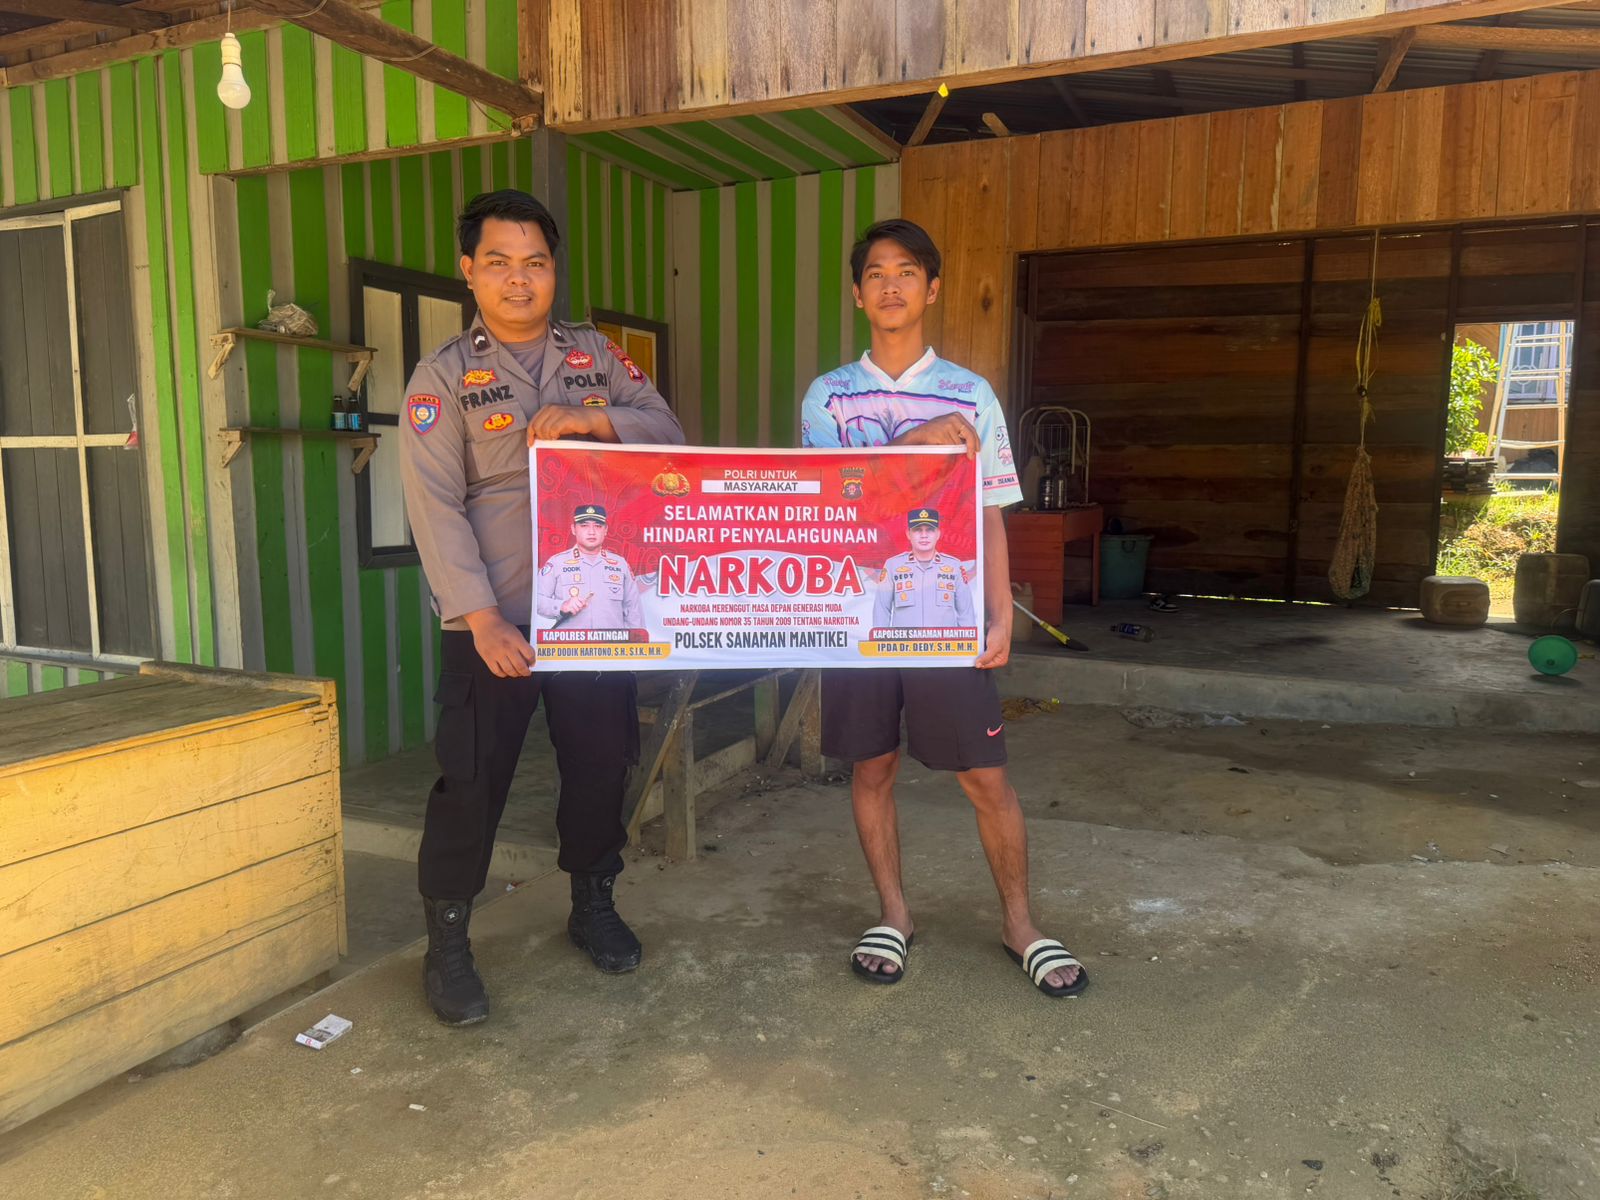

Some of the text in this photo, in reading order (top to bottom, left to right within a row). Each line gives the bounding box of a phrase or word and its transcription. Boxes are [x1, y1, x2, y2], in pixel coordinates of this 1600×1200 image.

[563, 372, 607, 389] POLRI
[460, 385, 514, 411] FRANZ
[724, 469, 798, 480] POLRI UNTUK
[724, 482, 799, 492] MASYARAKAT
[664, 505, 778, 522] SELAMATKAN
[784, 506, 819, 522] DIRI
[824, 506, 857, 522] DAN
[643, 527, 714, 543] HINDARI
[720, 528, 878, 543] PENYALAHGUNAAN
[658, 555, 865, 597] NARKOBA
[894, 573, 914, 581] DEDY
[937, 573, 955, 581] POLRI
[680, 603, 842, 613] NARKOBA MERENGGUT MASA DEPAN GENERASI MUDA
[663, 617, 860, 626] UNDANG-UNDANG NOMOR 35 TAHUN 2009 TENTANG NARKOTIKA
[542, 631, 629, 641] KAPOLRES KATINGAN
[873, 629, 976, 639] KAPOLSEK SANAMAN MANTIKEI
[675, 631, 848, 649] POLSEK SANAMAN MANTIKEI
[537, 647, 556, 657] AKBP
[557, 647, 579, 656] DODIK
[878, 643, 898, 652] IPDA
[900, 643, 911, 652] Dr.
[957, 642, 975, 651] M.H.
